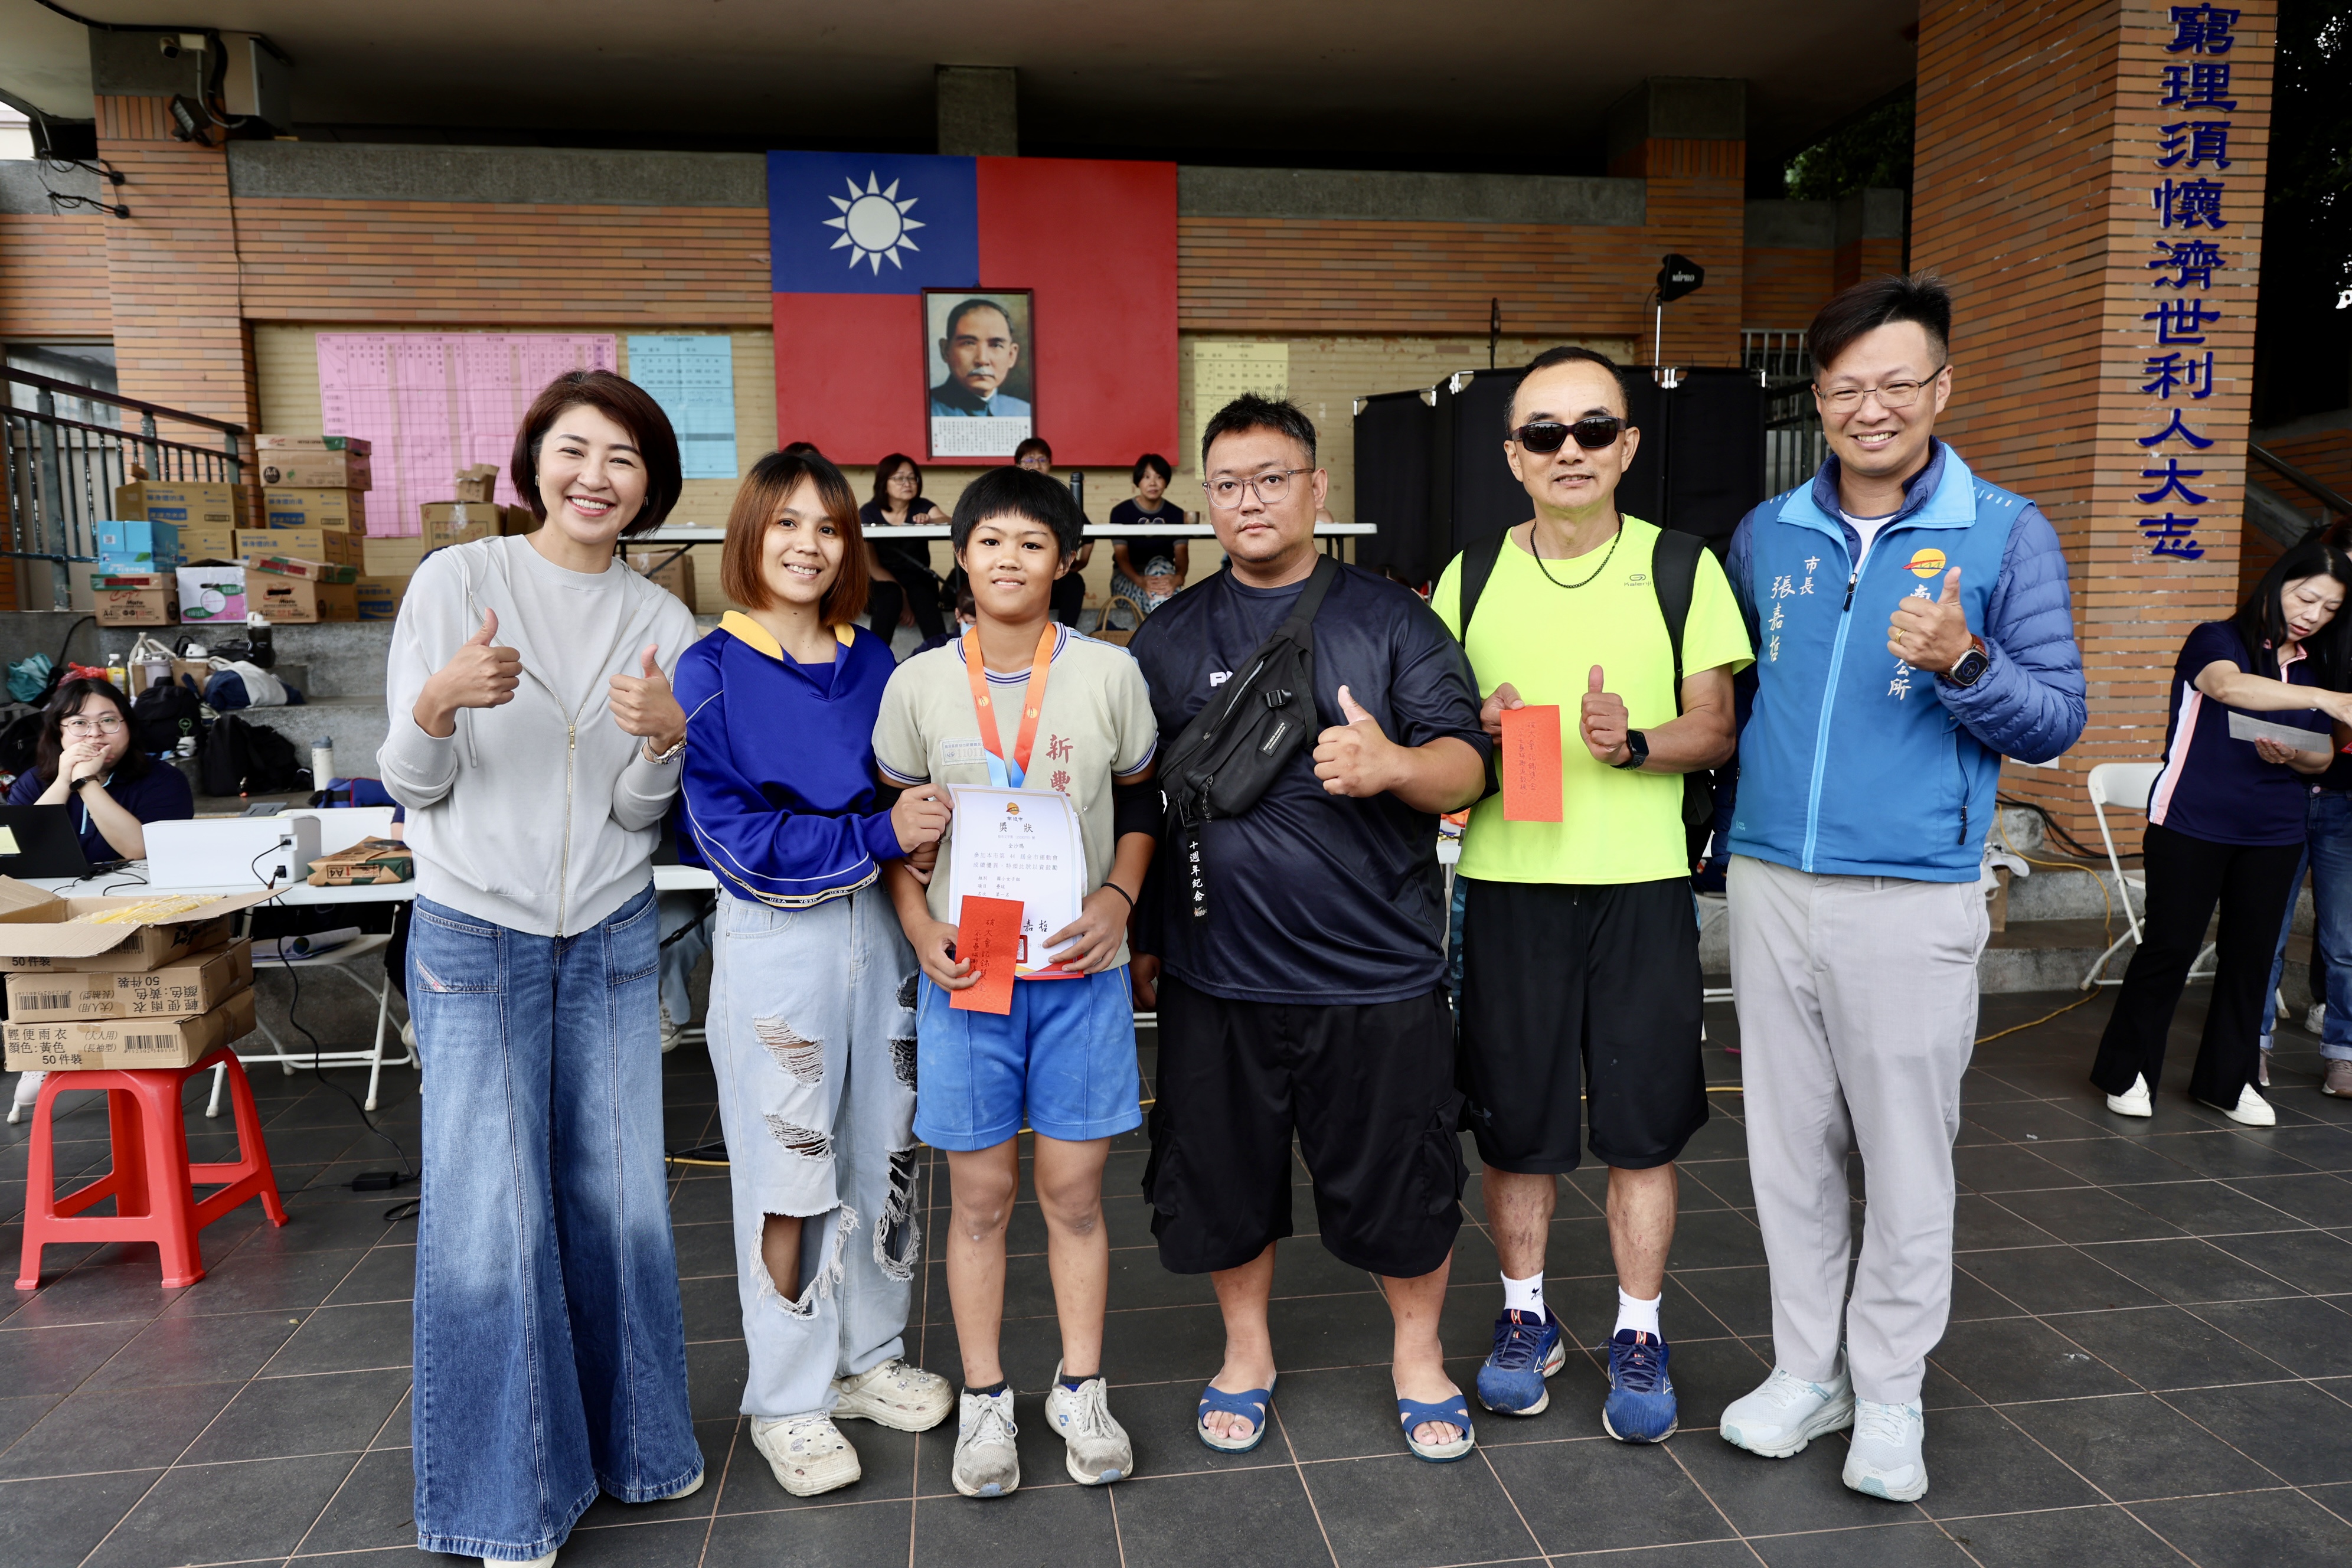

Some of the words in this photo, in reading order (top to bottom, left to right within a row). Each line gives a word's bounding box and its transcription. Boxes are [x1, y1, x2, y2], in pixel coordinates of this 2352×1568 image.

[2134, 2, 2240, 561] 窮理須懷濟世利人大志
[1799, 556, 1821, 596] 市長
[1768, 574, 1796, 663] 張嘉哲
[1887, 583, 1932, 701] 南公所
[1189, 841, 1205, 901] 十週年紀念
[1023, 919, 1047, 932] 嘉哲
[12, 957, 25, 966] 50
[117, 976, 142, 988] 件裝
[145, 976, 160, 986] 50
[79, 990, 115, 1000] (長袖型)
[78, 1002, 113, 1012] (大人用)
[133, 1000, 199, 1012] 輕便雨衣
[7, 1028, 67, 1041] 輕便雨衣
[84, 1031, 118, 1041] (大人用)
[83, 1043, 116, 1053] (長袖型)
[43, 1055, 56, 1064] 50
[58, 1054, 83, 1065] 件裝
